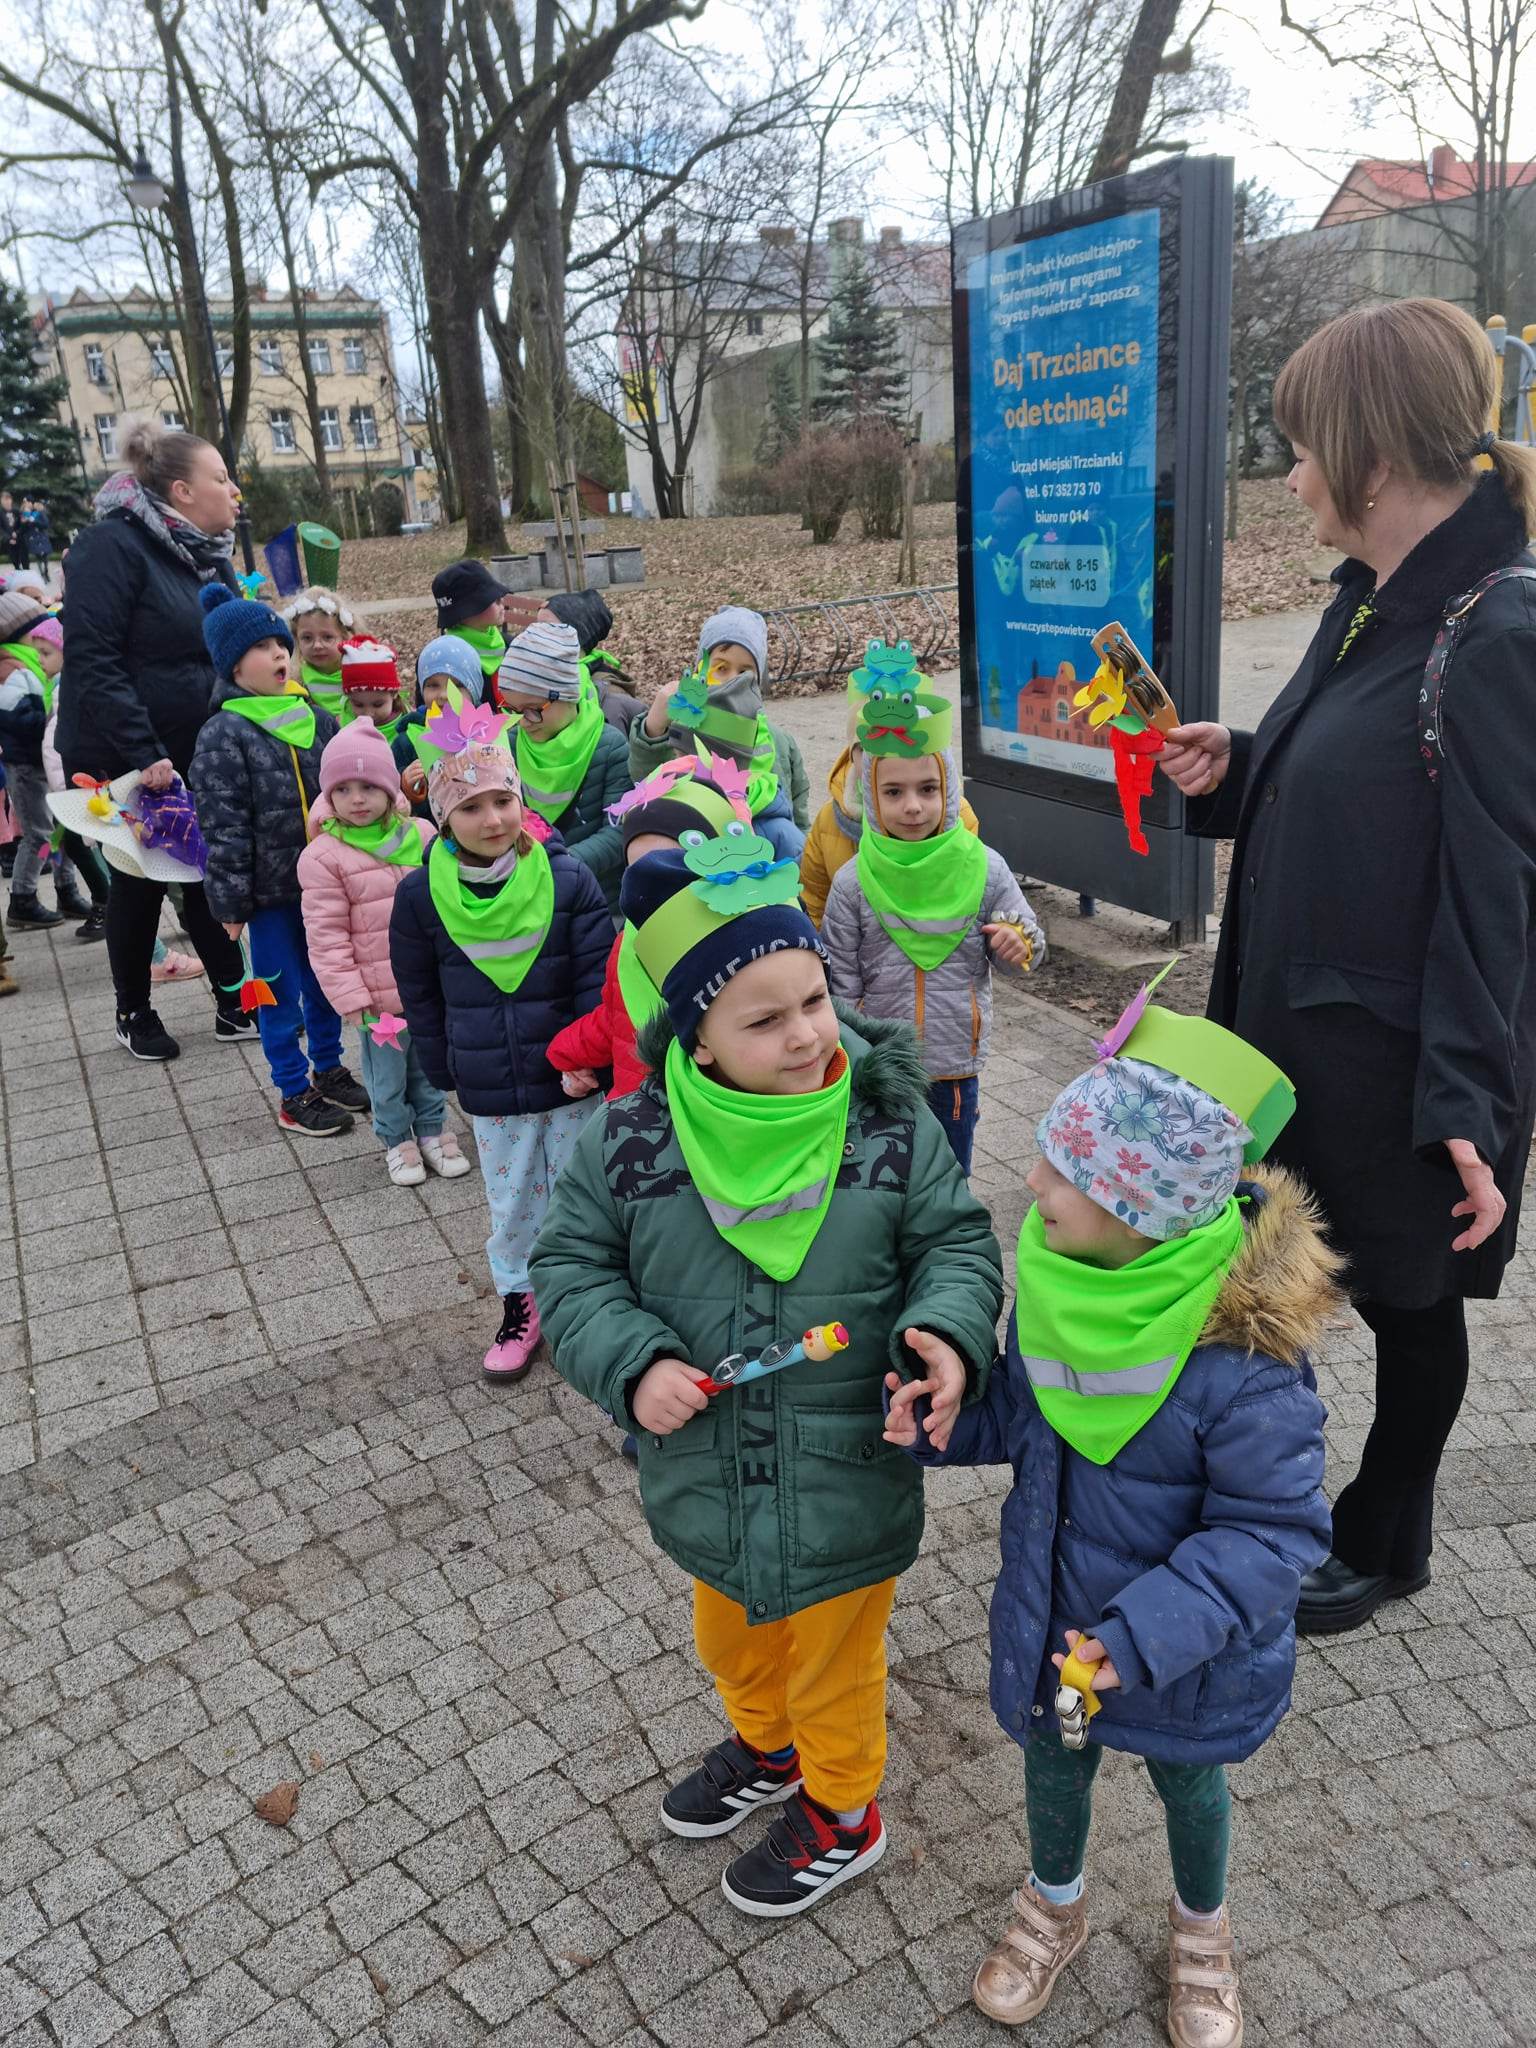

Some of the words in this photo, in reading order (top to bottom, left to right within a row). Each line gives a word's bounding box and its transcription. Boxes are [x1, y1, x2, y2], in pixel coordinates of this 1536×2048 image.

[1026, 257, 1056, 276] Punkt
[1057, 238, 1143, 267] Konsultacyjno-
[1070, 265, 1121, 291] programu
[1089, 285, 1140, 307] zaprasza
[993, 353, 1024, 391] Daj
[1027, 341, 1141, 380] Trzciance
[1004, 384, 1129, 429] odetchnąć!
[1011, 459, 1038, 475] Urząd
[1039, 457, 1072, 474] Miejski
[1073, 452, 1123, 469] Trzcianki
[1025, 485, 1040, 498] tel.
[1042, 484, 1054, 497] 67
[1056, 484, 1072, 496] 352
[1073, 483, 1086, 496] 73
[1088, 482, 1101, 495] 70
[1035, 510, 1058, 523] biuro
[1059, 514, 1068, 523] nr
[1030, 559, 1070, 571] czwartek
[1076, 559, 1098, 571] 8-15
[1030, 577, 1056, 591] piątek
[1070, 578, 1096, 591] 10-13
